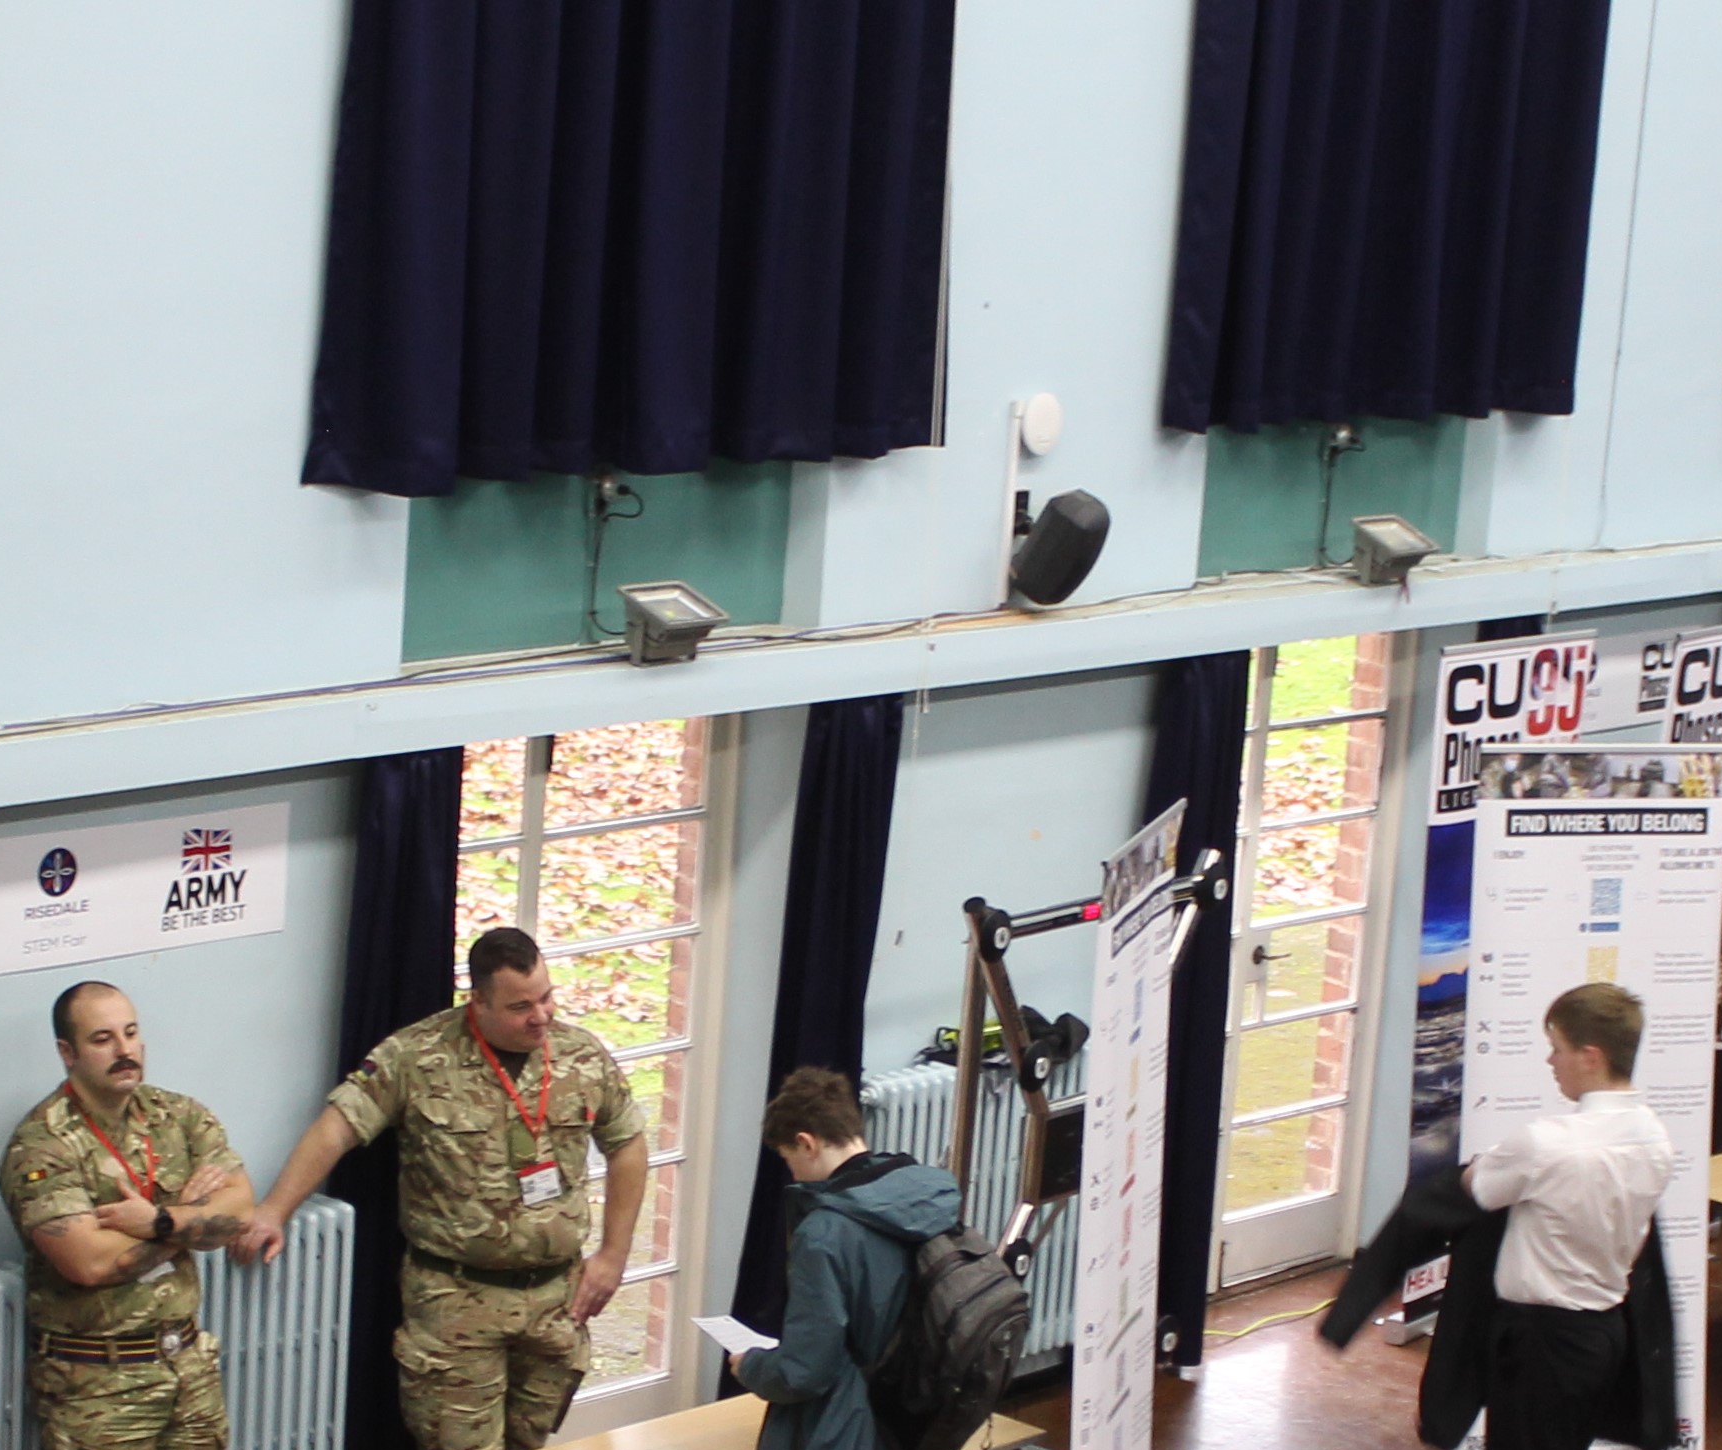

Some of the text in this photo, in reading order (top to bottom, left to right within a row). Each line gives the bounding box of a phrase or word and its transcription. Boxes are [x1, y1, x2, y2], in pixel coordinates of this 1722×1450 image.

[1446, 658, 1527, 726] CU
[1528, 645, 1588, 736] 95
[1511, 812, 1705, 834] FIND WHERE YOU BELONG
[163, 869, 247, 914] ARMY
[23, 899, 90, 921] RISEDALE
[161, 904, 247, 932] BE THE BEST
